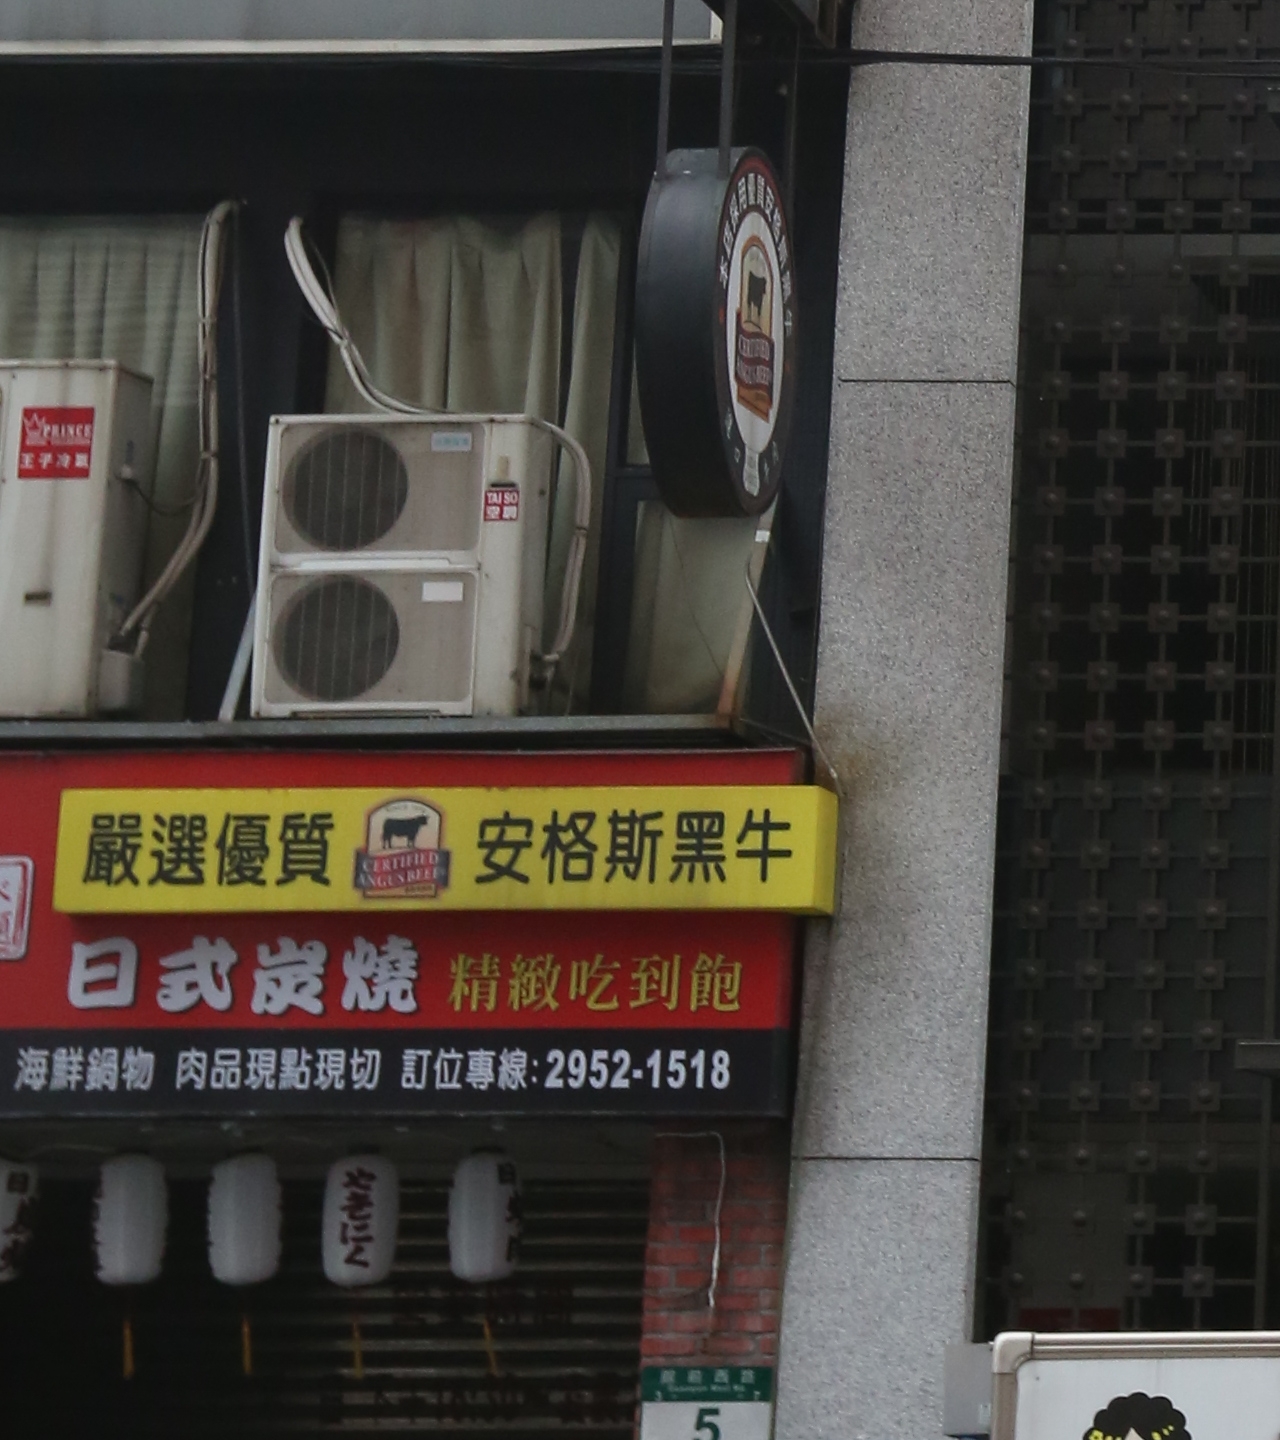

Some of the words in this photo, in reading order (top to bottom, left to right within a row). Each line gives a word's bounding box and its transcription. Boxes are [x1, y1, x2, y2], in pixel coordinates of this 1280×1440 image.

[82, 812, 335, 888] 嚴選優質
[474, 808, 794, 886] 安格斯黑牛
[67, 935, 421, 1015] 日式炭燒
[448, 952, 744, 1013] 精緻吃到飽
[14, 1047, 155, 1091] 海鮮鍋物
[175, 1046, 381, 1091] 肉品現點現切
